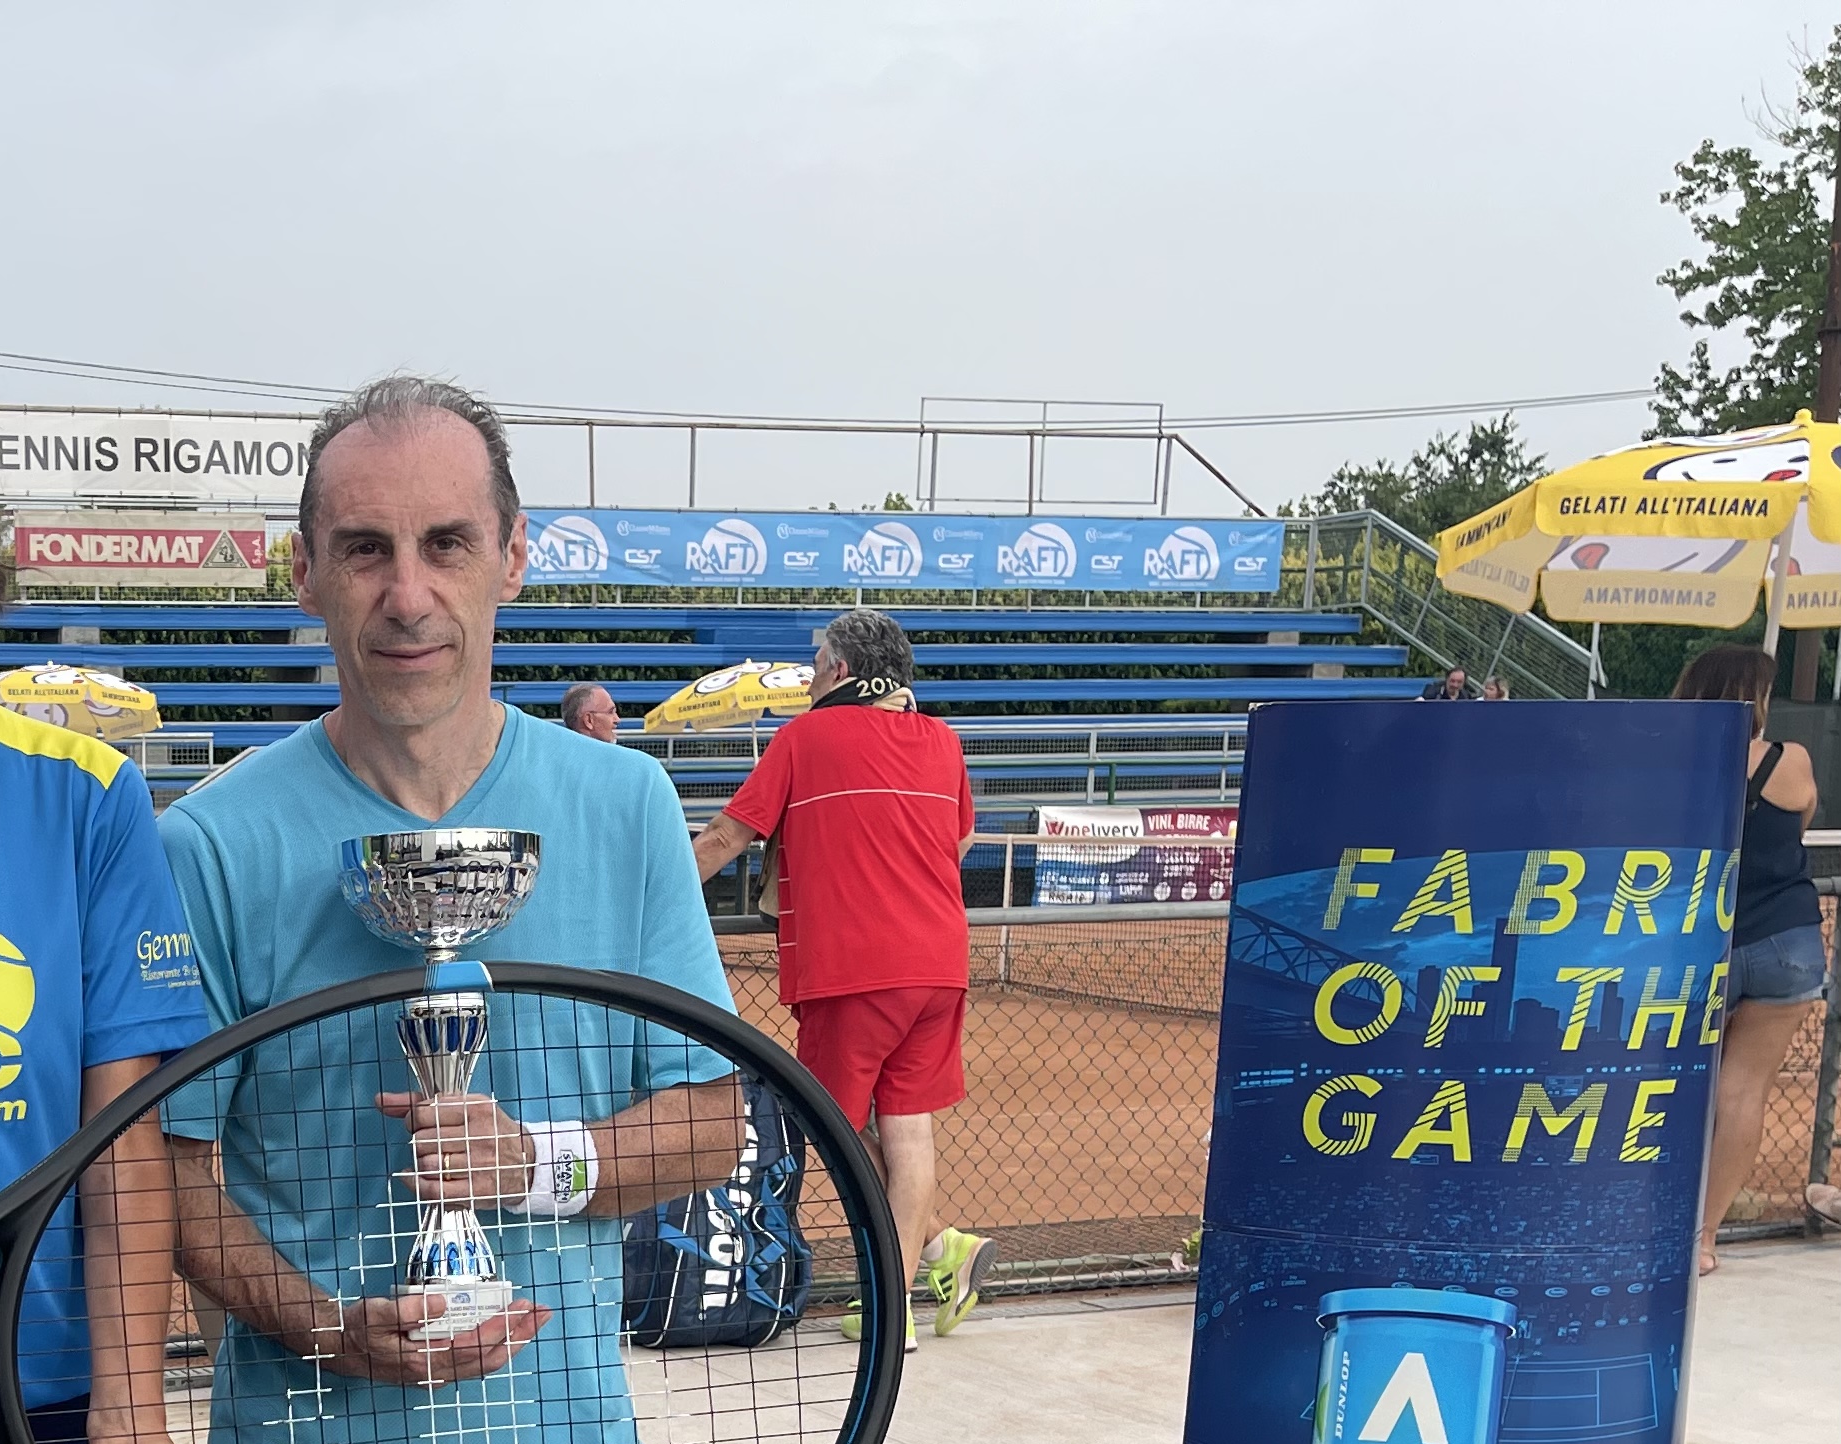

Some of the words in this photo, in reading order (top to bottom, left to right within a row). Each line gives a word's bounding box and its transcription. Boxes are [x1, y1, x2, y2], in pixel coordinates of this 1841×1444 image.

[134, 436, 310, 477] RIGAMON
[1559, 495, 1628, 516] GELATI
[1635, 496, 1770, 518] ALL'ITALIANA
[28, 533, 204, 564] FONDERMAT
[624, 549, 662, 564] CST
[685, 541, 754, 571] RAFT
[783, 551, 820, 567] CST
[843, 543, 909, 573] RAFT
[938, 553, 975, 569] CST
[997, 545, 1064, 575] RAFT
[1091, 554, 1124, 570] CST
[1143, 548, 1206, 577] RAFT
[1234, 556, 1268, 572] CST
[1147, 814, 1175, 831] VINI,
[1176, 813, 1212, 831] BIRRE
[1313, 960, 1503, 1050] OF
[1555, 961, 1729, 1052] THE
[1302, 1073, 1678, 1164] GAME
[1334, 1350, 1351, 1440] DUNLOP
